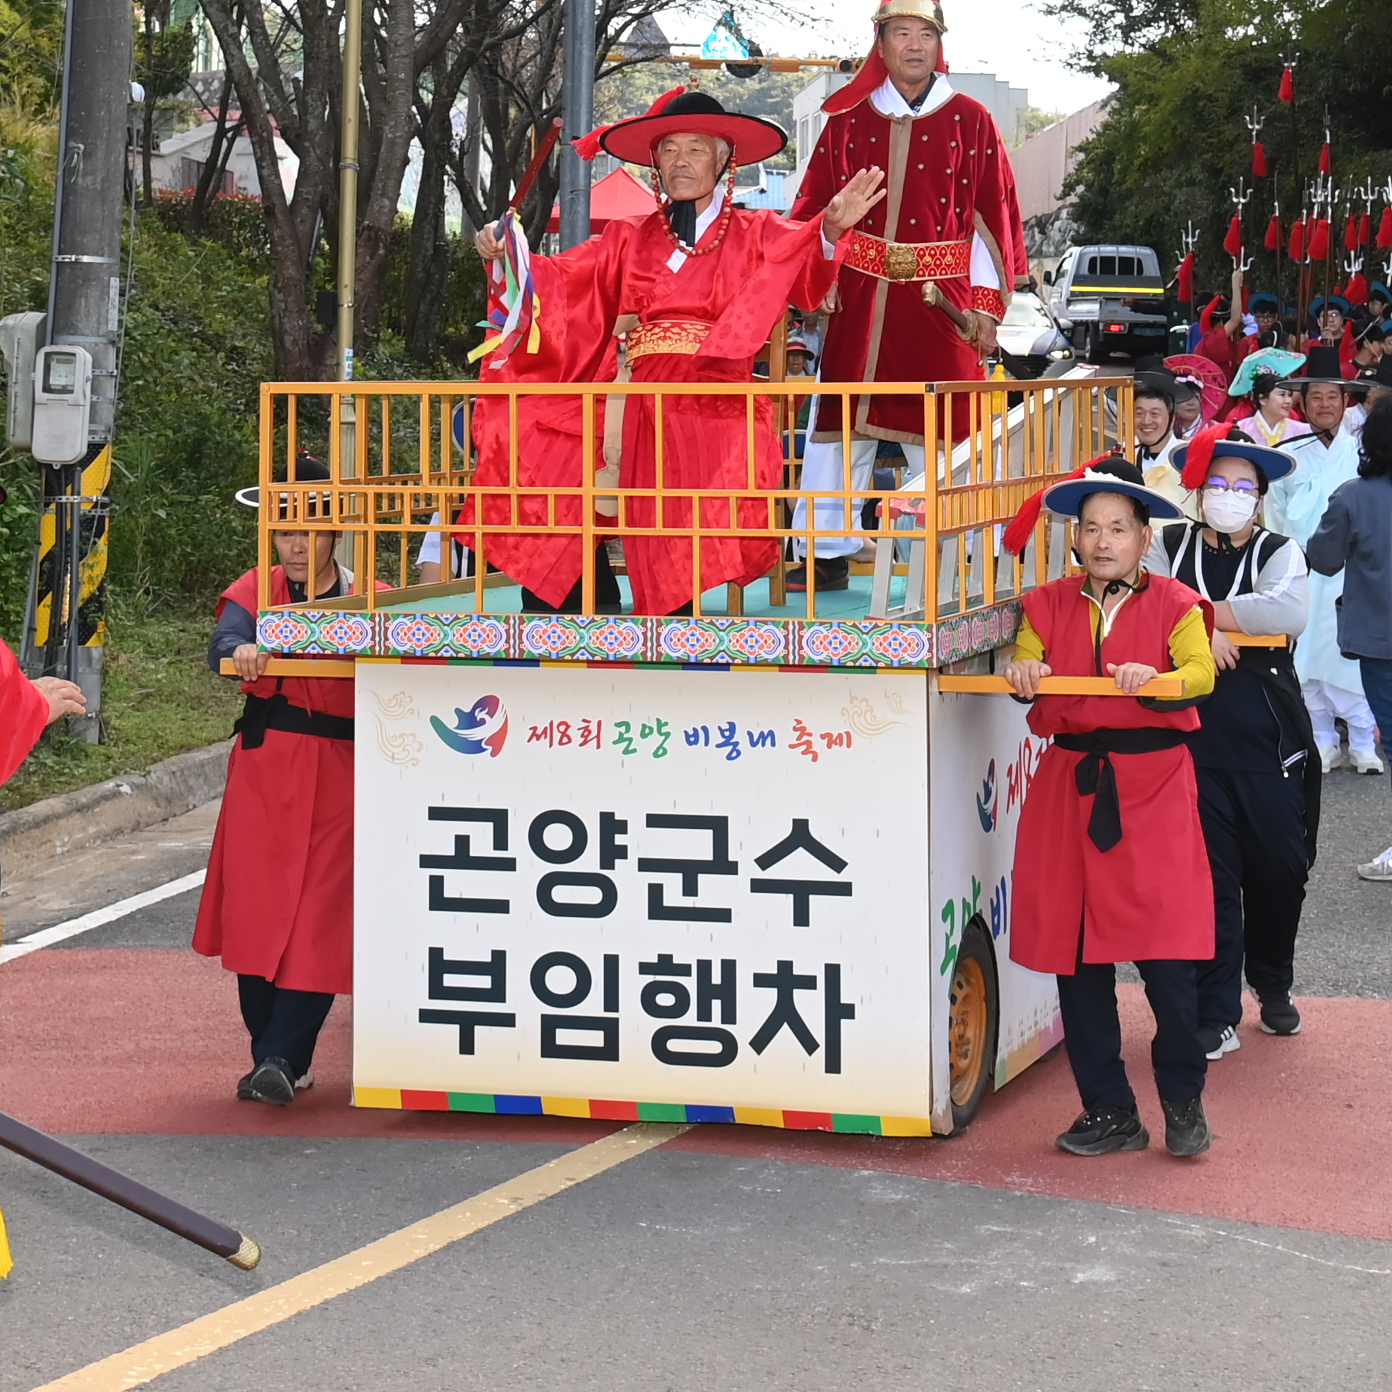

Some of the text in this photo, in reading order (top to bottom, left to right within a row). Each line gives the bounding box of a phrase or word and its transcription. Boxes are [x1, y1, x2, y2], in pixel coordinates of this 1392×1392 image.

[526, 717, 853, 763] 제8회 곤양 비봉내 축제
[418, 806, 853, 927] 곤양군수
[417, 946, 857, 1075] 부임행차
